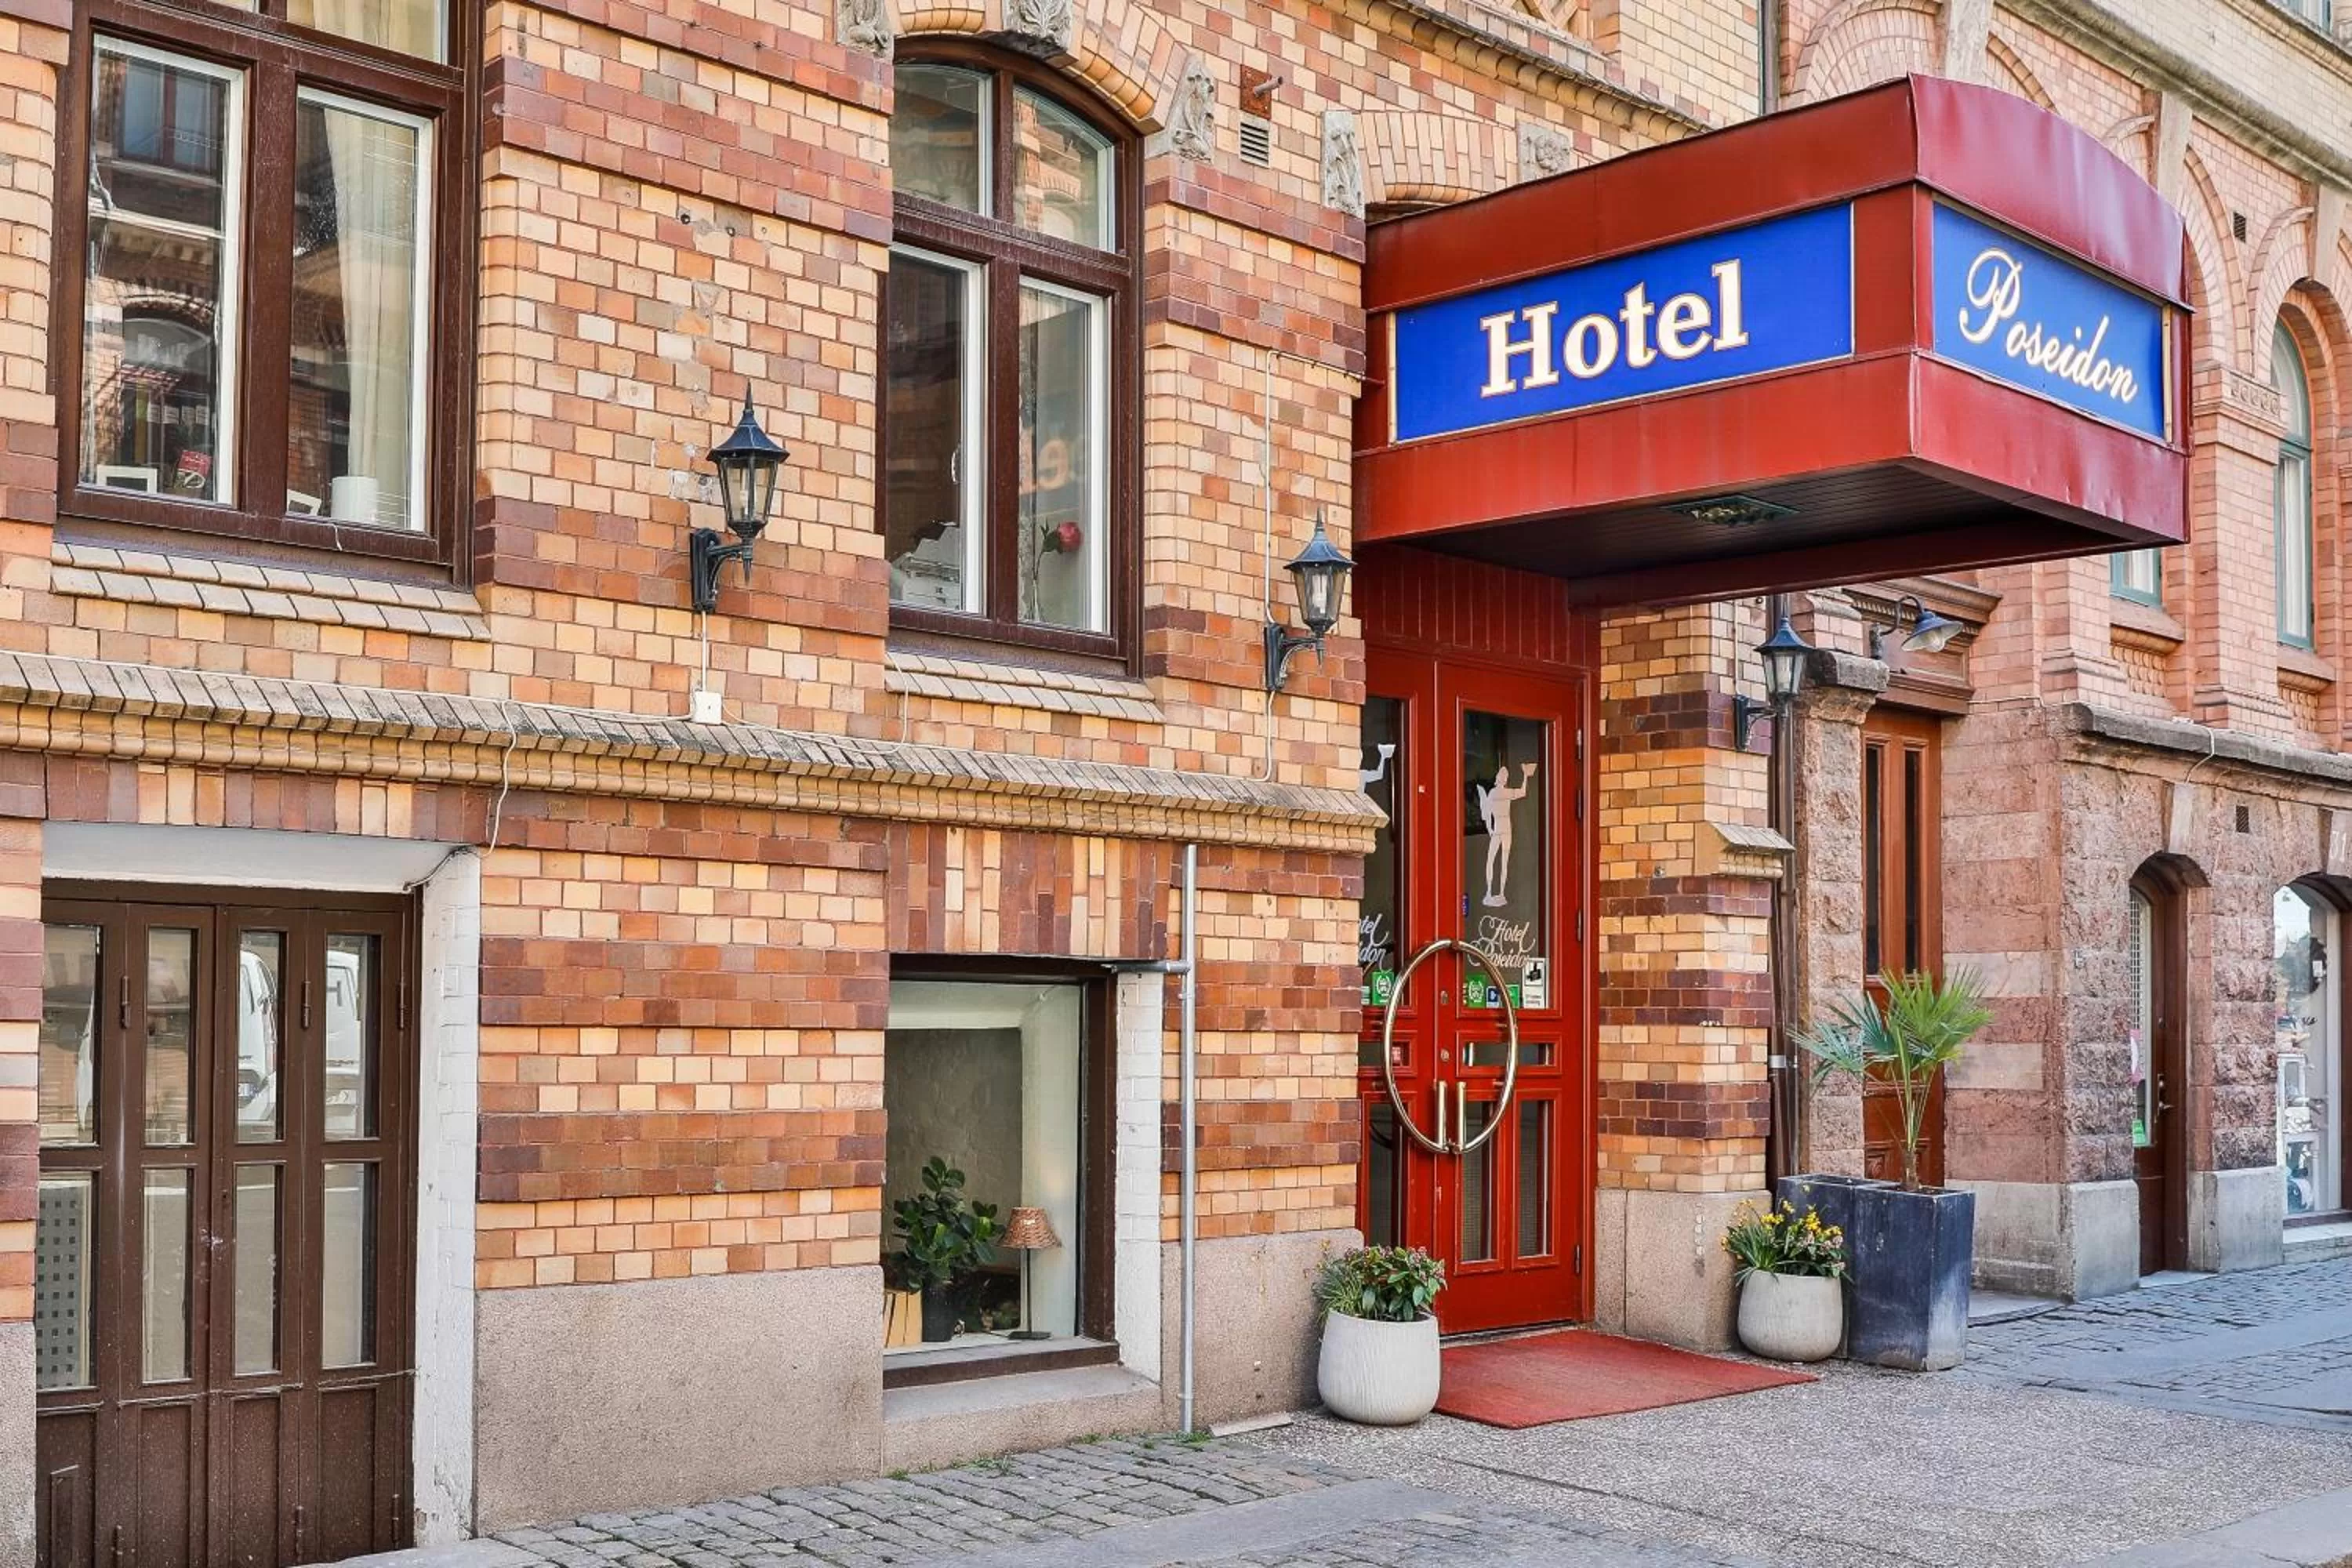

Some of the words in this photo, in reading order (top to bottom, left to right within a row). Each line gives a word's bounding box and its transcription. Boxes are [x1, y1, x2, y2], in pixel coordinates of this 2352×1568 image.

[1480, 259, 1750, 398] Hotel
[1958, 248, 2138, 404] Poseidon
[1359, 913, 1389, 947] tel
[1478, 915, 1536, 954] Hotel
